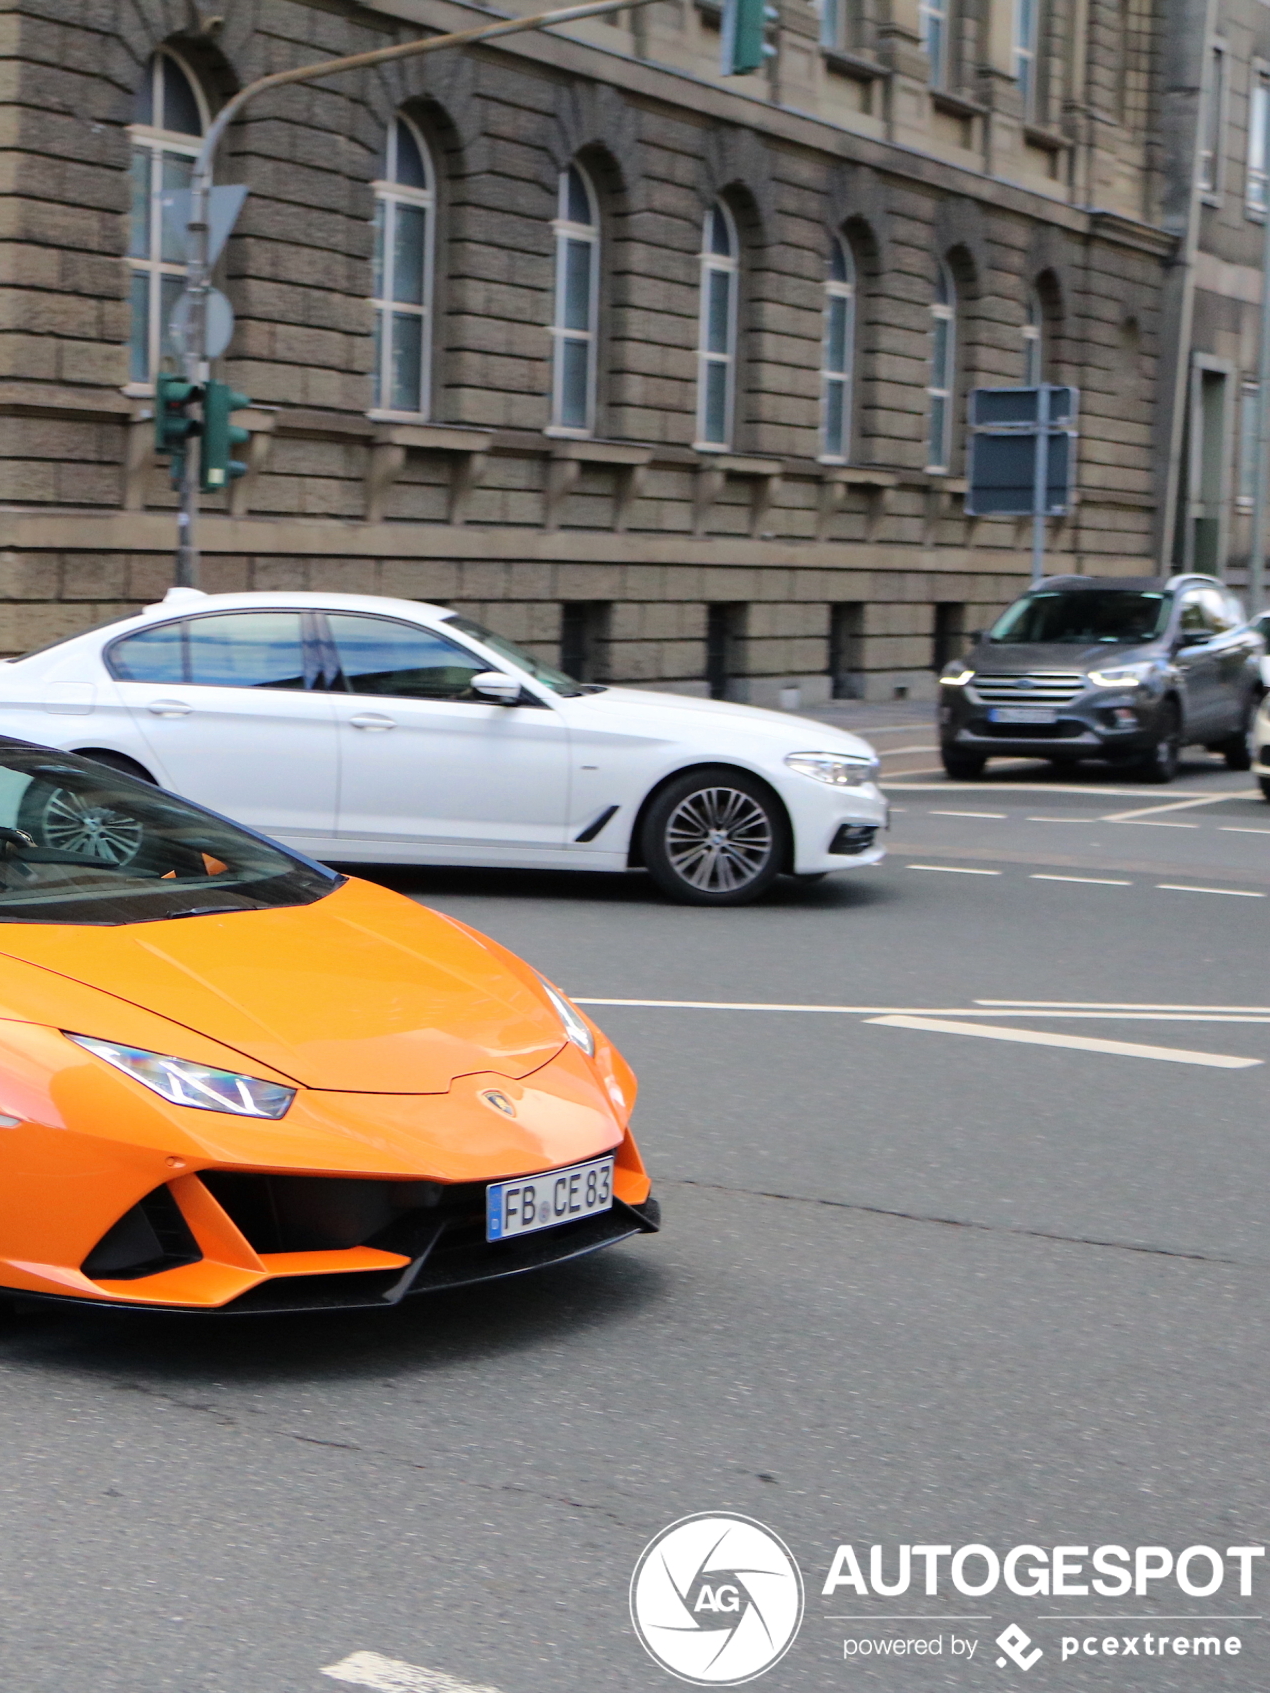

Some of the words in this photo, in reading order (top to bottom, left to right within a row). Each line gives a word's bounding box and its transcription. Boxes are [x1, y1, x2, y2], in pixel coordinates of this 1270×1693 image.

[505, 1185, 535, 1229] FB
[554, 1173, 582, 1216] CE
[586, 1166, 610, 1208] 83
